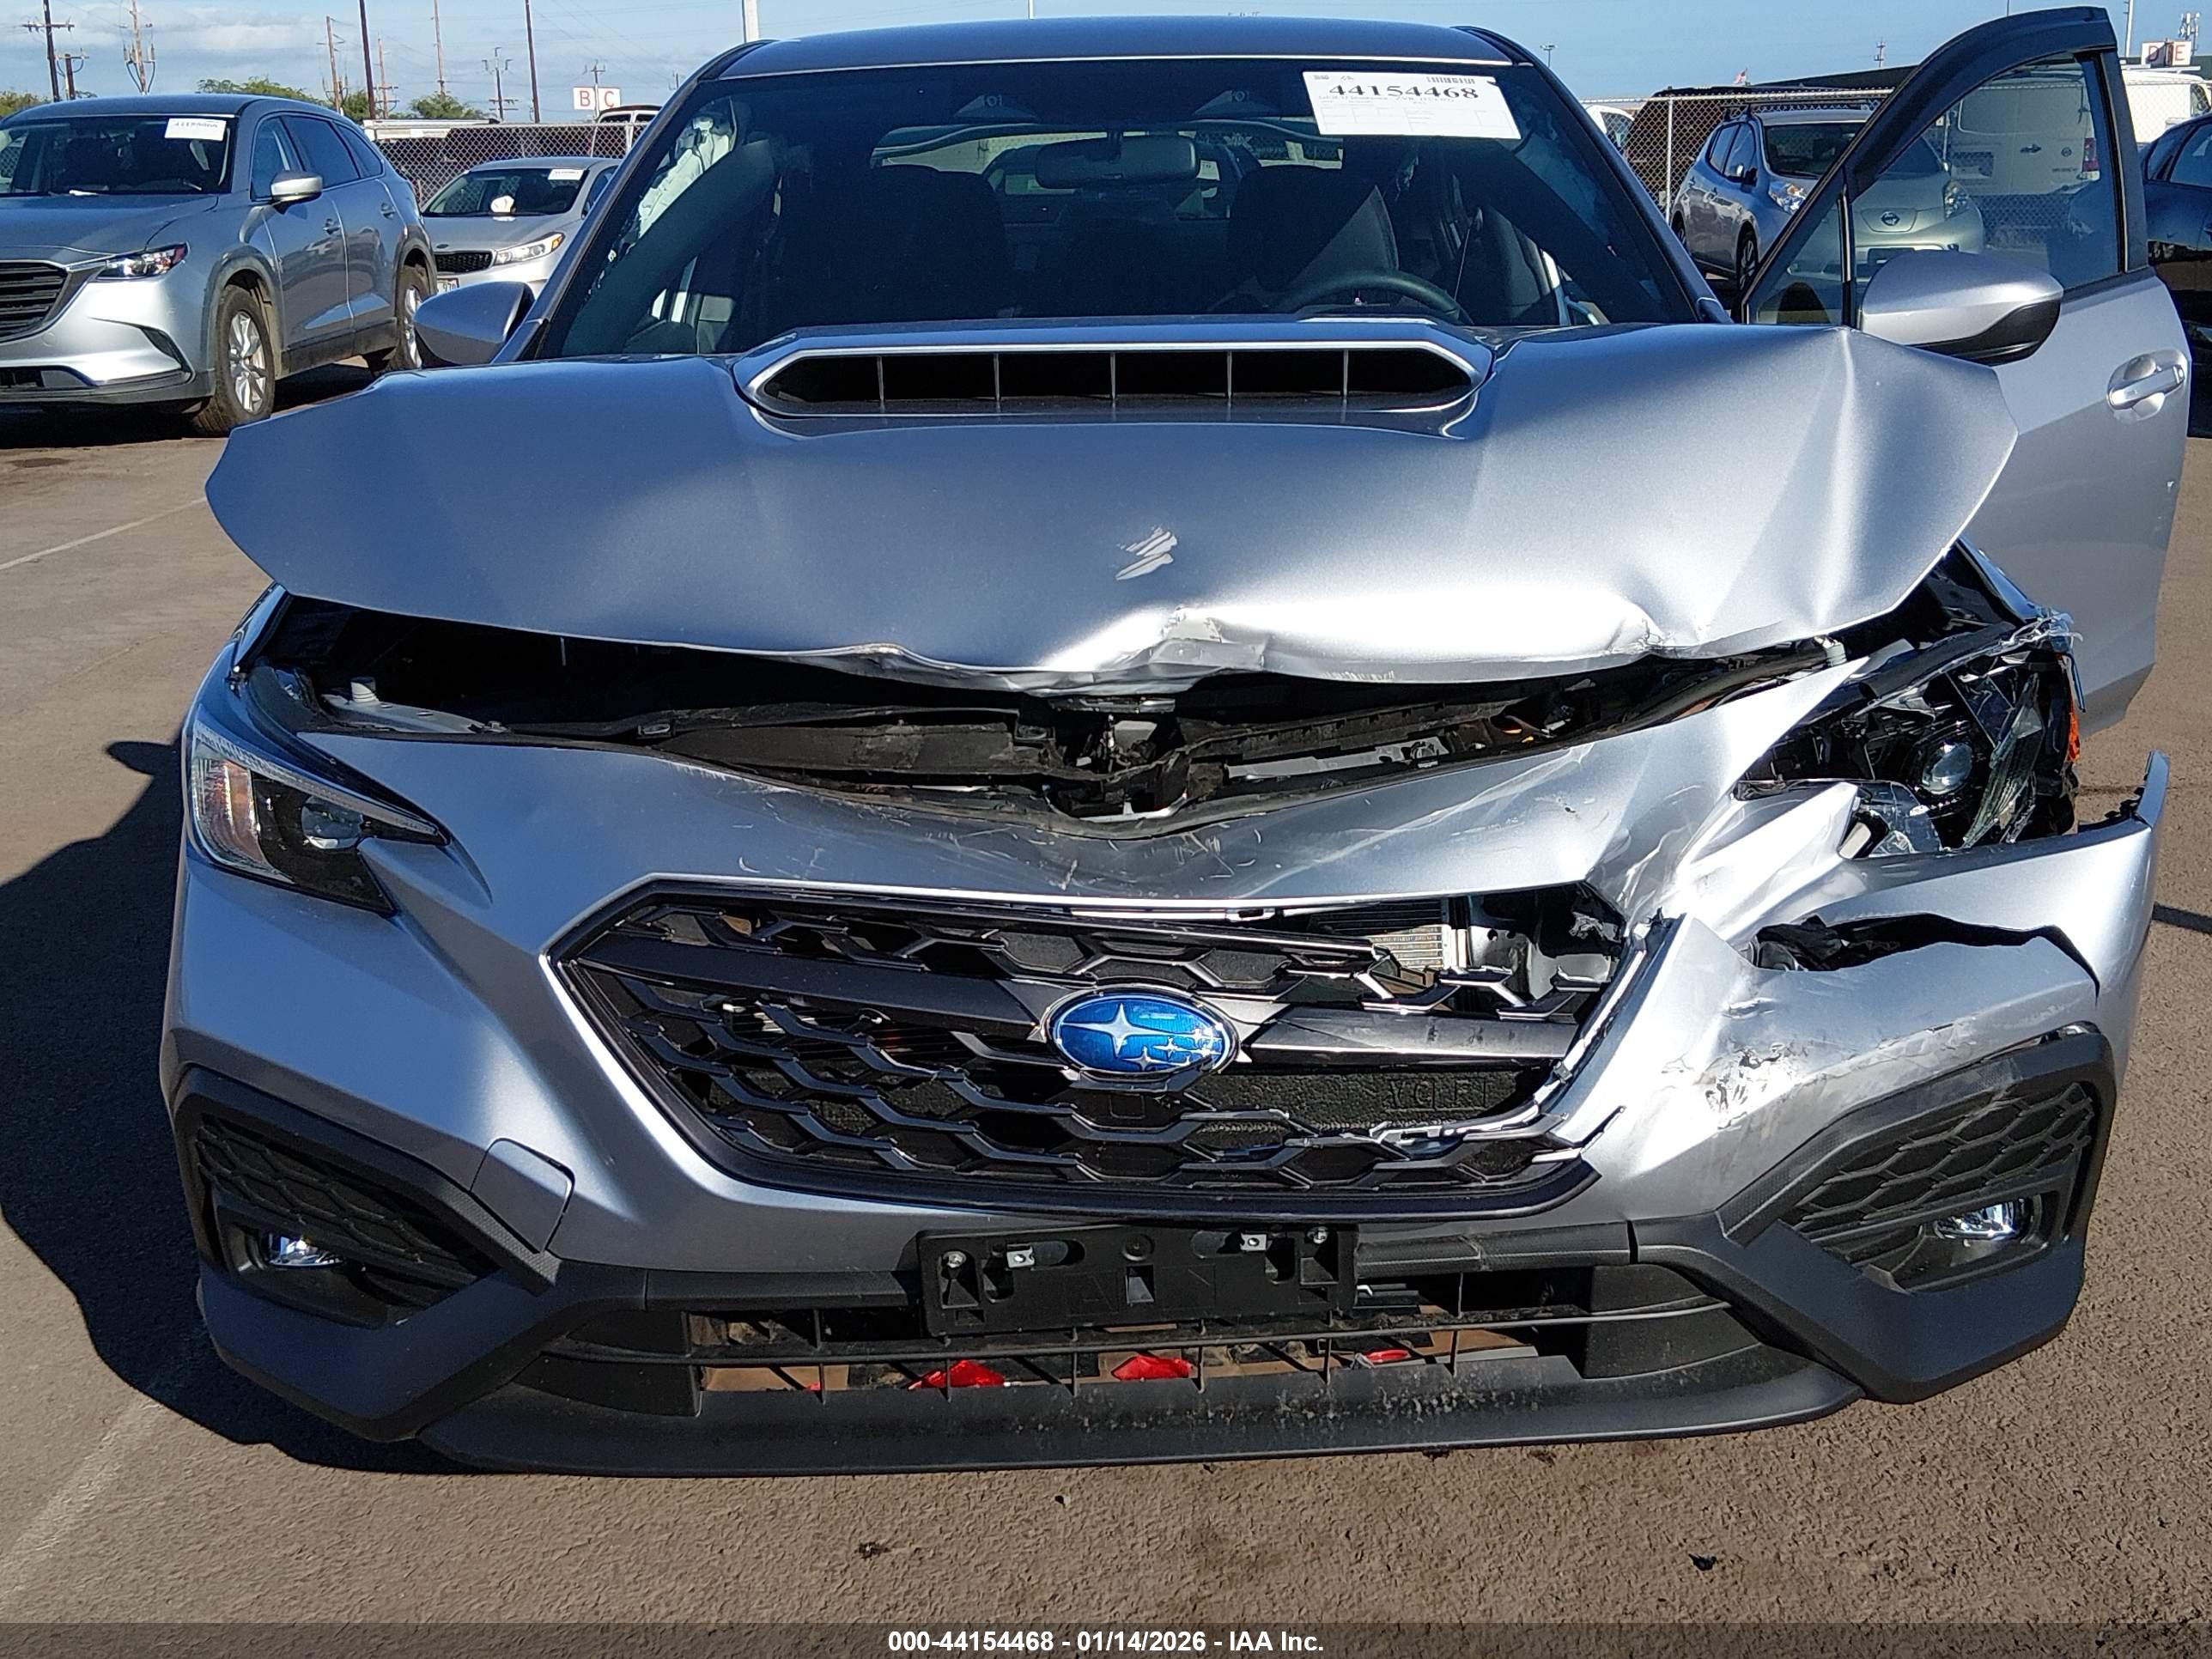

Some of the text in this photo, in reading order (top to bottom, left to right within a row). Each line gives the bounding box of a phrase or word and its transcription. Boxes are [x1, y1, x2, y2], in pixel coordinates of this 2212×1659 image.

[2174, 45, 2186, 61] E
[580, 90, 591, 106] B
[604, 90, 615, 107] C
[1329, 84, 1479, 100] 44154468
